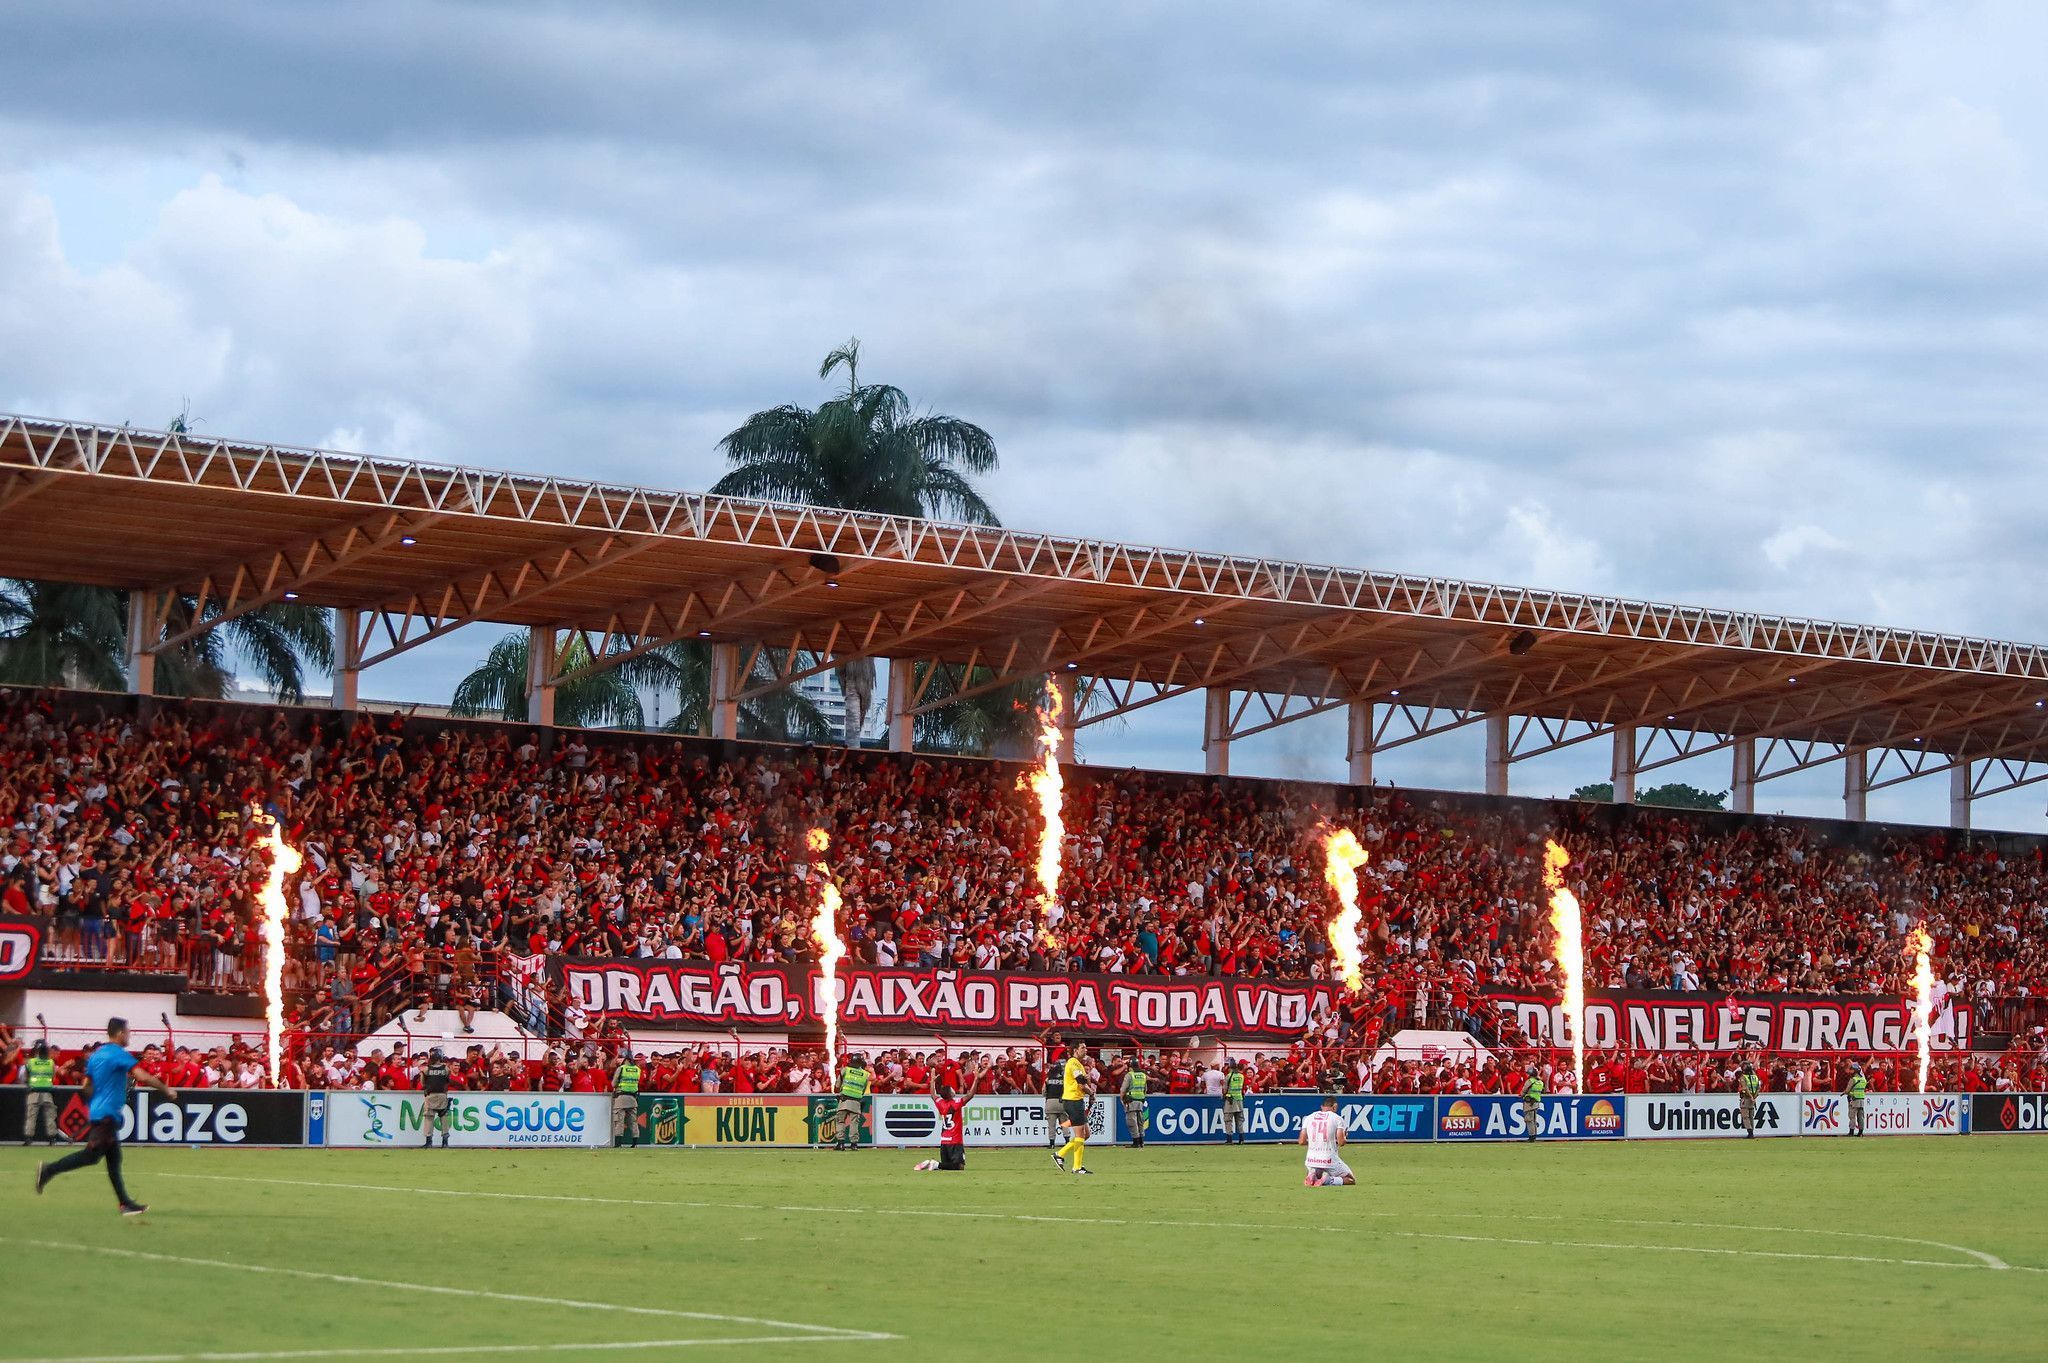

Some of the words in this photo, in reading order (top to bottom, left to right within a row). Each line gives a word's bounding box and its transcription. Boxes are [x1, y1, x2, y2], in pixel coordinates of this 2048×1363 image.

[569, 964, 800, 1020] DRAGÃO,
[812, 970, 994, 1019] PAIXÃO
[1009, 982, 1103, 1023] PRA
[1112, 986, 1229, 1028] TODA
[1630, 1006, 1771, 1050] NELES
[485, 1099, 585, 1133] Saúde
[716, 1106, 778, 1143] KUAT
[1311, 1121, 1329, 1143] 14
[1857, 1107, 1910, 1130] ristal
[508, 1134, 538, 1143] PLANO
[540, 1134, 552, 1143] DE
[553, 1133, 583, 1143] SAÚDE
